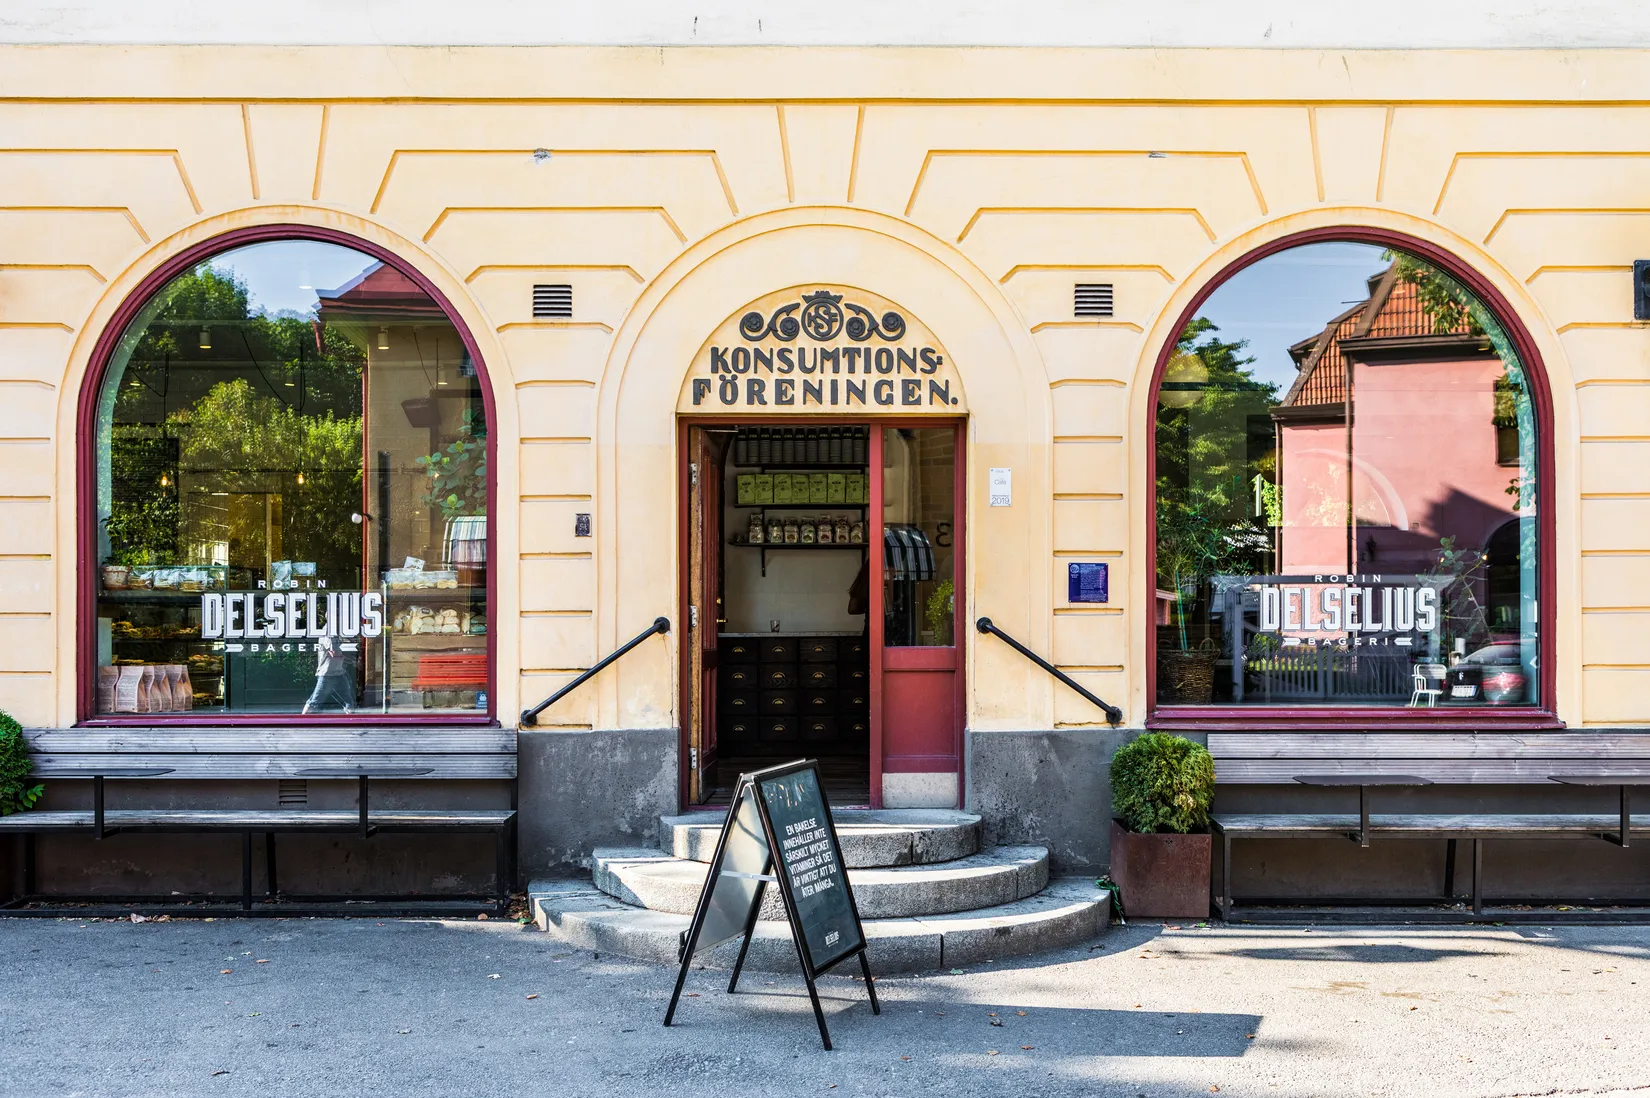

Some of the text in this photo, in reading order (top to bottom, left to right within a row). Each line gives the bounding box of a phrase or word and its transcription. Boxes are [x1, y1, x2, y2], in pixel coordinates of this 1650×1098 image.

[692, 374, 959, 406] FÖRENINGEN.
[257, 579, 328, 589] ROBIN
[1314, 574, 1383, 583] ROBIN
[201, 592, 383, 639] DELSELIUS
[1260, 587, 1437, 633] DELSELIUS
[250, 643, 334, 652] BAGERI
[1307, 637, 1389, 646] BAGERI
[785, 817, 817, 836] EN BAKELSE
[783, 827, 827, 850] INNEHÅLLER INTE
[808, 839, 829, 855] MYCKET
[789, 851, 833, 875] VITAMINER SÅ DET
[800, 869, 819, 885] VIKTIGT
[819, 865, 829, 878] ATT
[828, 862, 837, 874] DU
